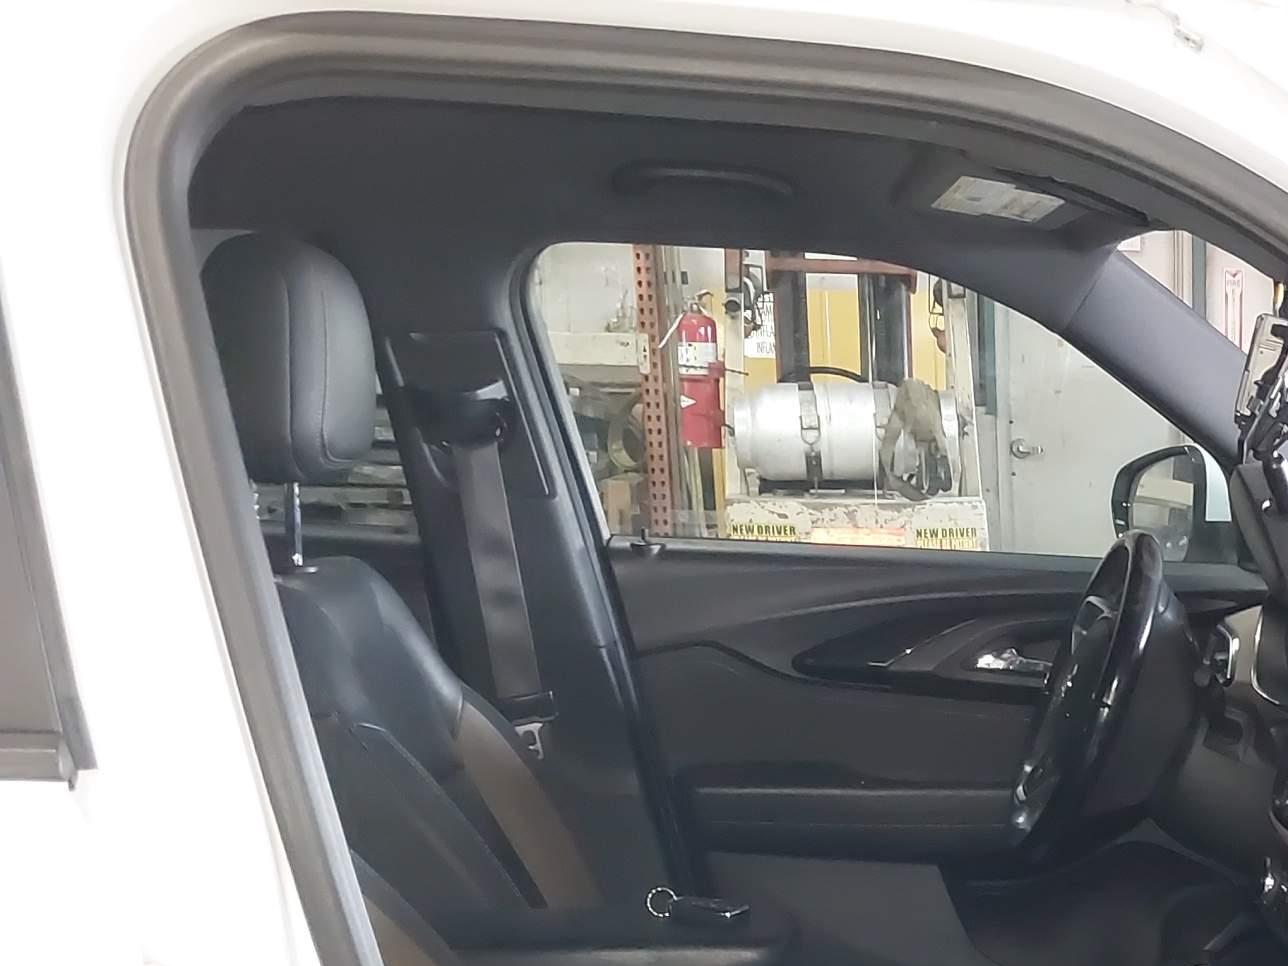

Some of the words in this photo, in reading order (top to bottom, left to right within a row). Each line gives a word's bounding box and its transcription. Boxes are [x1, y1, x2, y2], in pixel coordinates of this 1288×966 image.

[732, 523, 754, 536] NEW
[756, 524, 796, 537] DRIVER
[916, 527, 939, 539] NEW
[941, 527, 977, 538] DRIVER
